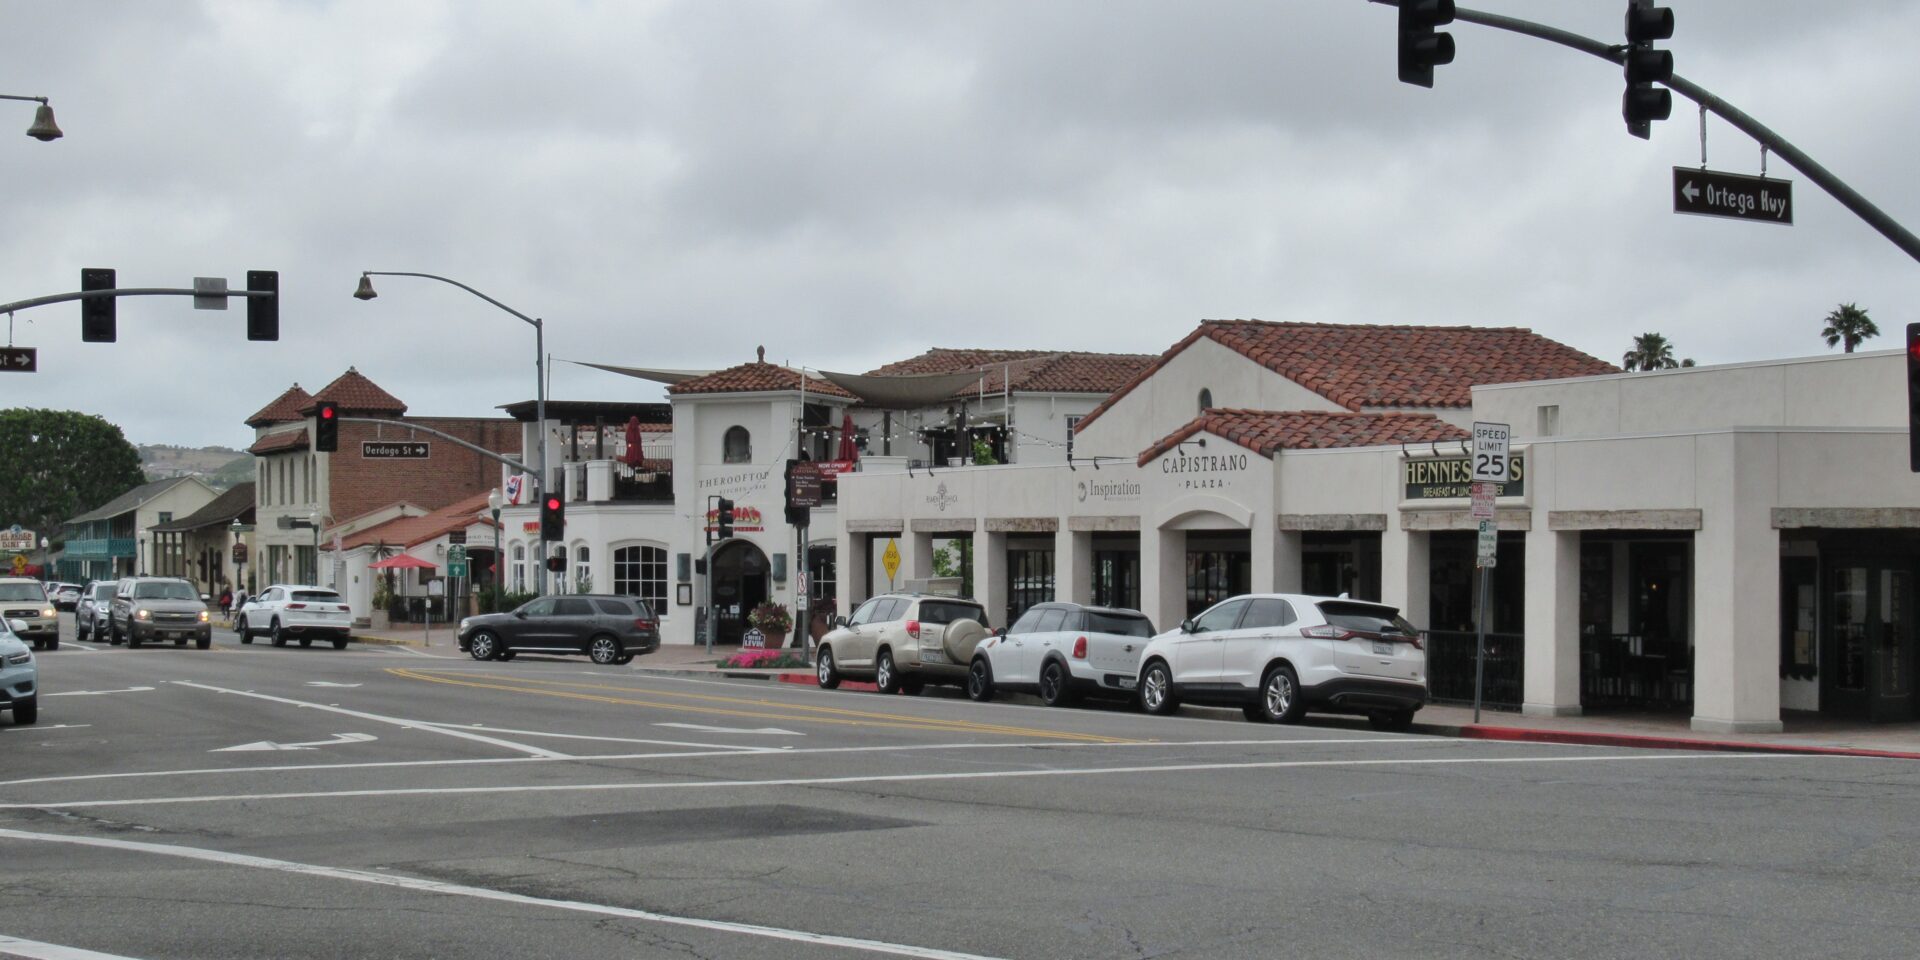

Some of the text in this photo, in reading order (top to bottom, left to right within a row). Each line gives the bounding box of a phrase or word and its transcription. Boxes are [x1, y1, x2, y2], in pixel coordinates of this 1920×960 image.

[1706, 183, 1787, 219] Ortega Hwy
[1476, 429, 1507, 440] SPEED
[365, 445, 412, 457] Verdugo St
[1478, 441, 1503, 452] LIMIT
[1162, 454, 1248, 474] CAPISTRANO
[1476, 453, 1505, 476] 25
[1185, 479, 1223, 489] PLAZA
[1090, 479, 1142, 502] Inspiration
[1423, 486, 1451, 498] BREAKFAST
